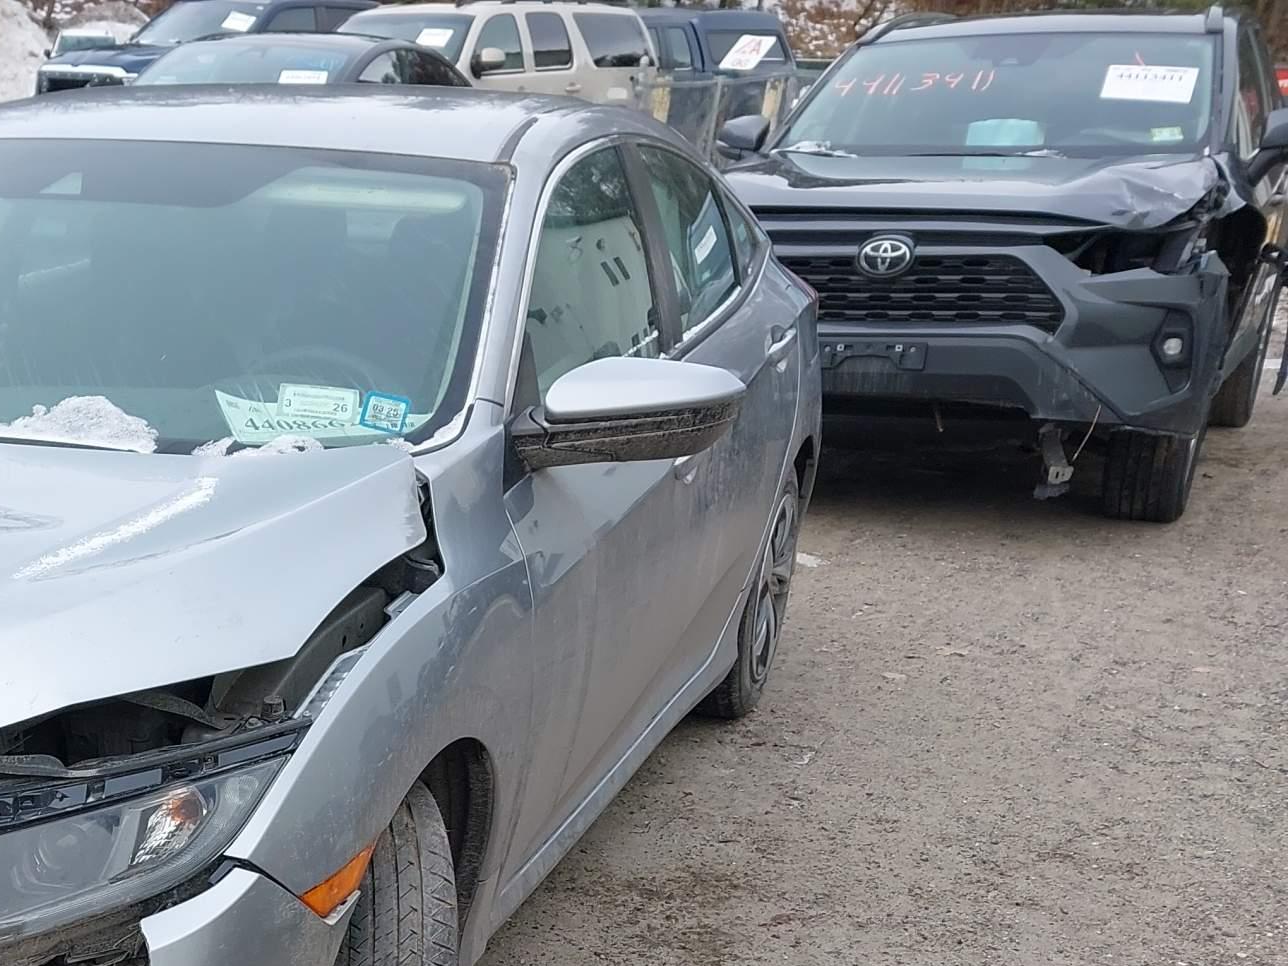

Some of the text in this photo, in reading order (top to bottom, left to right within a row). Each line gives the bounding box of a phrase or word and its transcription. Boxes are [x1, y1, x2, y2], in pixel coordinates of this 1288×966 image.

[284, 398, 292, 408] 3
[332, 402, 348, 413] 26
[372, 403, 384, 413] 03
[244, 417, 360, 432] 440866
